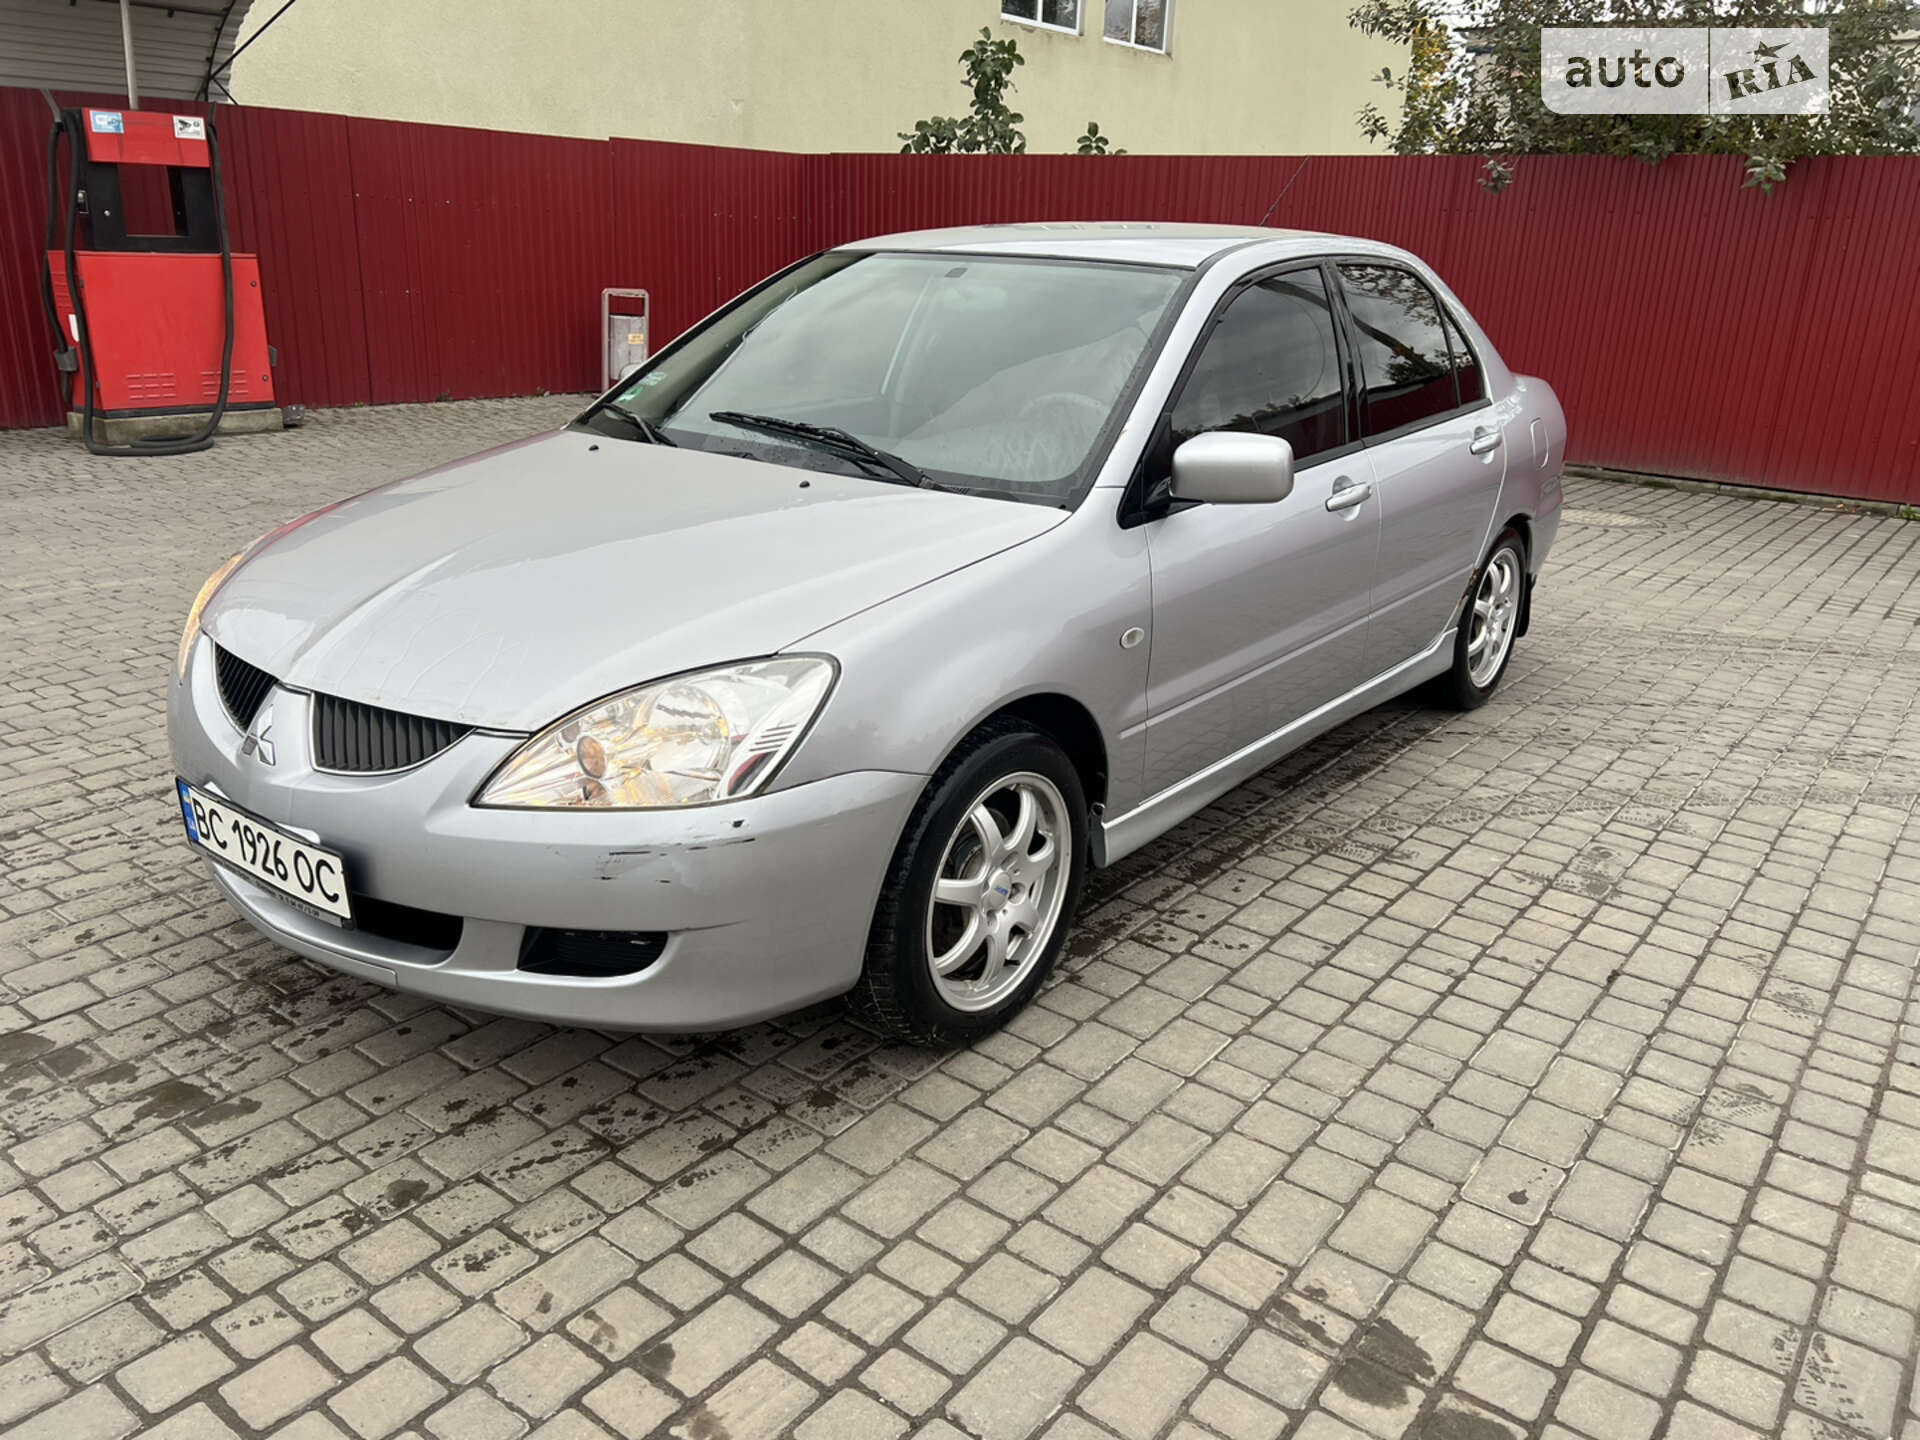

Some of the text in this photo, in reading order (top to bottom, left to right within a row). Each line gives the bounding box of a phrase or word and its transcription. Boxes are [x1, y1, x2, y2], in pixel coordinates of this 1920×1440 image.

[191, 797, 228, 850] BC
[231, 819, 289, 882] 1926
[293, 849, 340, 904] OC
